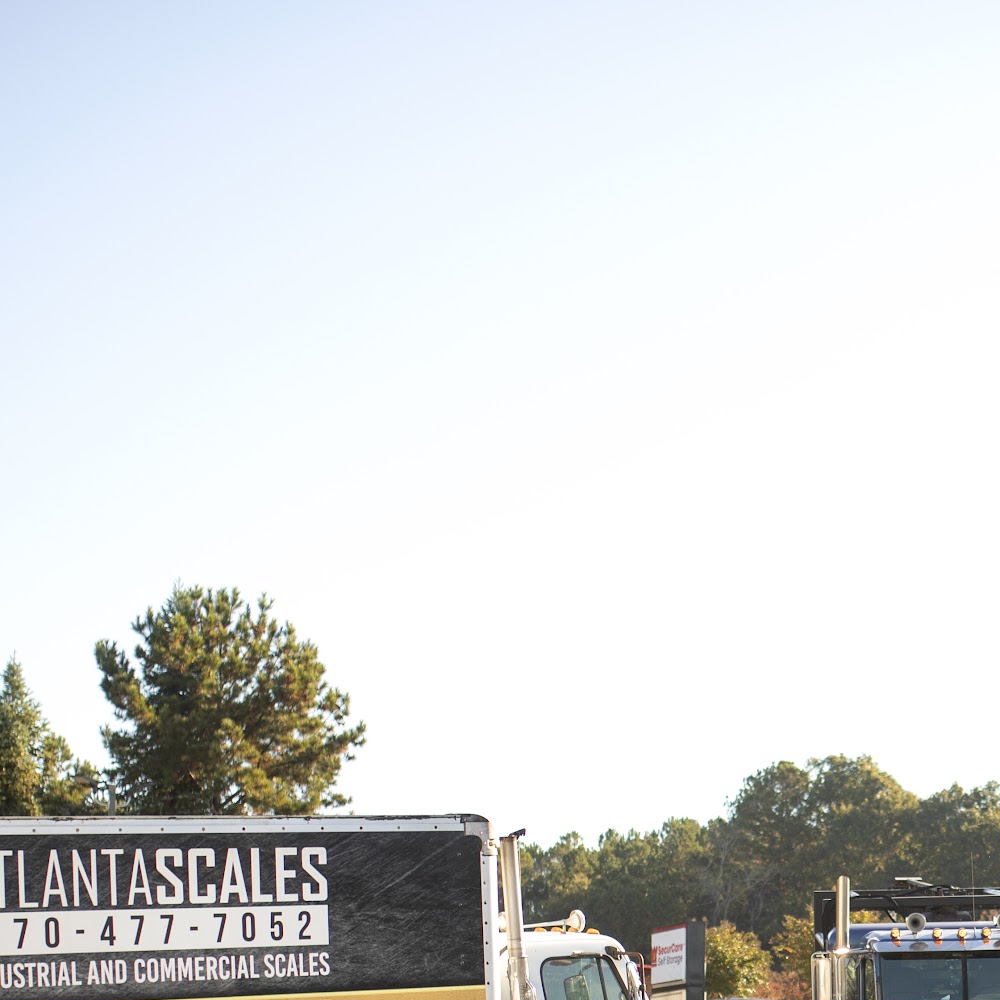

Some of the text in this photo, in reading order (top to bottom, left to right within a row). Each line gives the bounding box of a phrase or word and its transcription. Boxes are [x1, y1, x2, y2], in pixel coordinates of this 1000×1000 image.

[0, 846, 329, 909] TLANTASCALES
[87, 959, 128, 985] AND
[134, 955, 260, 984] COMMERCIAL
[264, 952, 331, 978] SCALES
